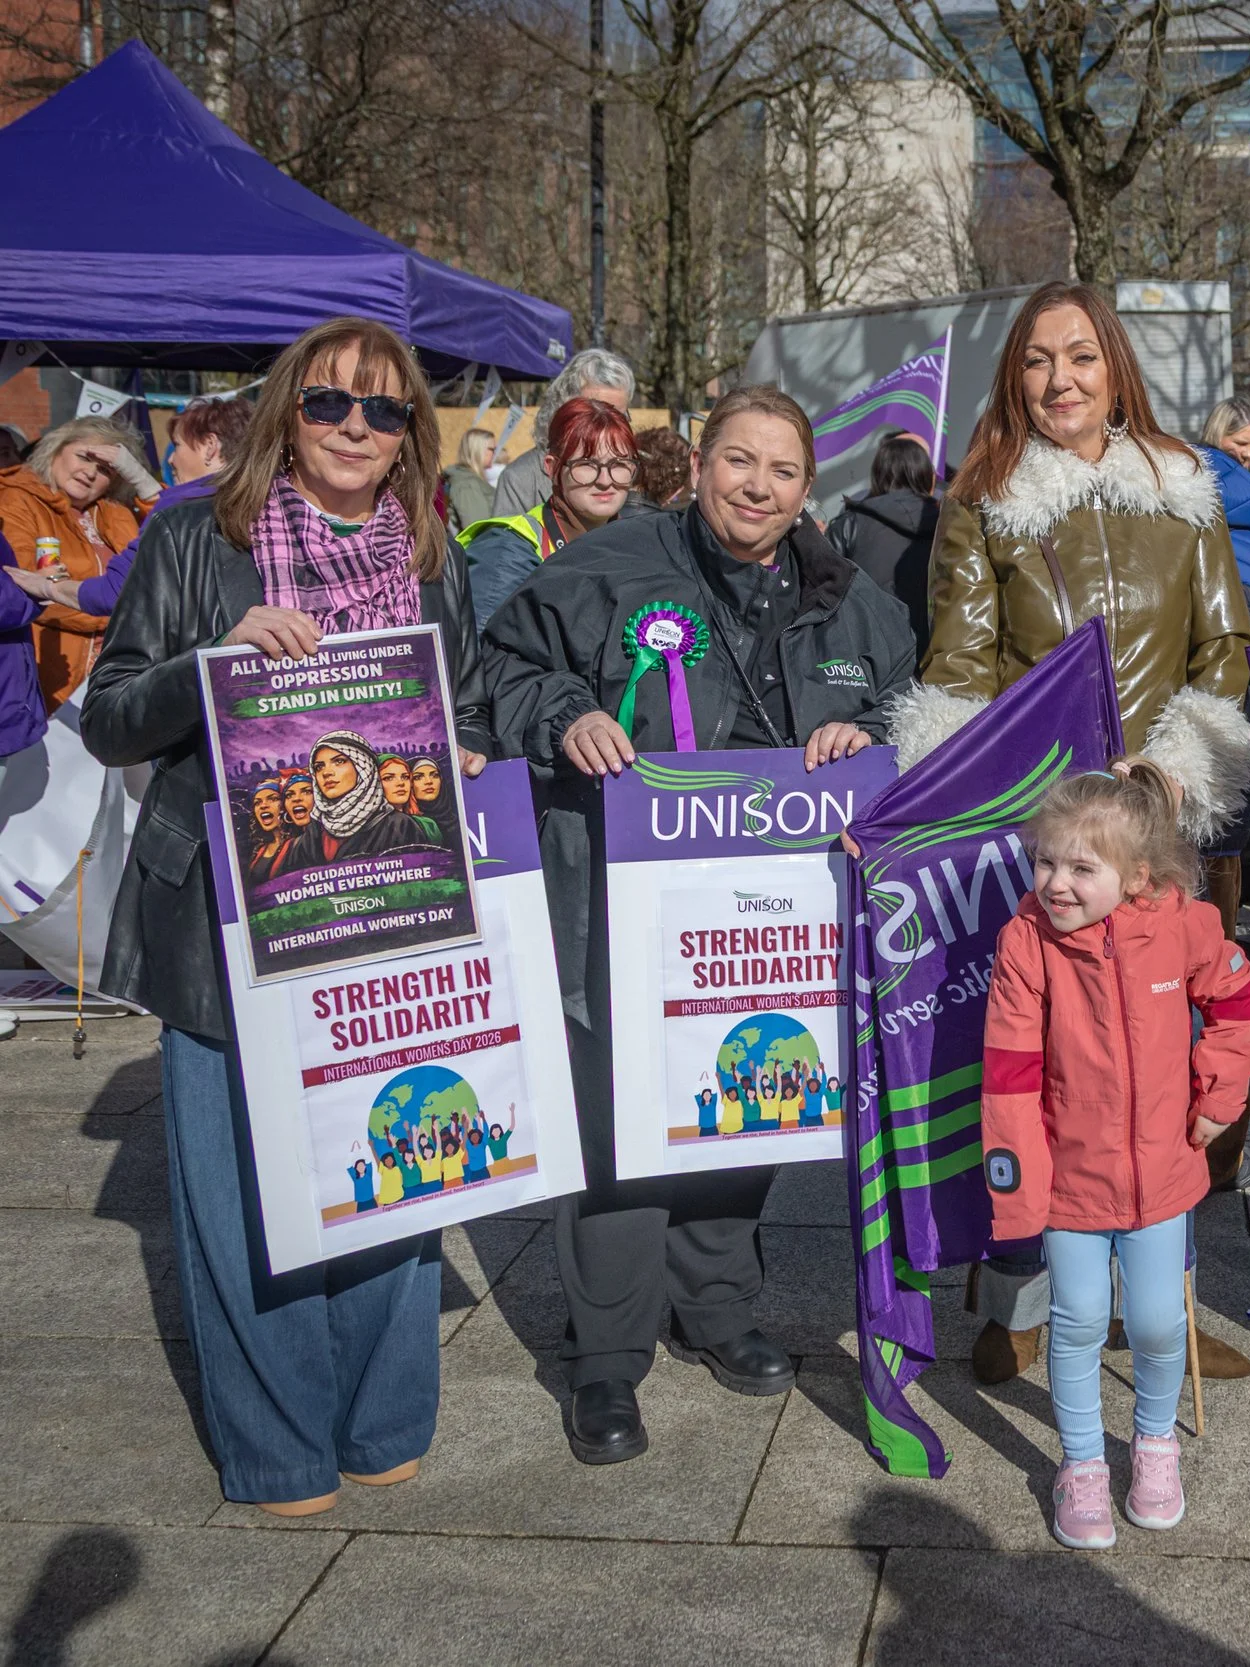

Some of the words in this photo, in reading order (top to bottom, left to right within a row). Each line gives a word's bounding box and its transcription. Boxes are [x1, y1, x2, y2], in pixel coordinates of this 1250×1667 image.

[230, 660, 261, 677] ALL
[262, 651, 330, 672] WOMEN
[332, 649, 367, 663] LIVING
[368, 643, 413, 659] UNDER
[271, 663, 383, 690] OPPRESSION
[258, 692, 317, 713] STAND
[320, 689, 340, 704] IN
[342, 682, 403, 701] UNITY!
[651, 790, 854, 841] UNISON
[274, 882, 335, 905] WOMEN
[338, 867, 432, 892] EVERYWHERE
[302, 862, 372, 885] SOLIDARITY
[374, 859, 403, 871] WITH
[334, 896, 386, 915] UNISON
[737, 898, 793, 913] UNISON
[268, 922, 367, 953] INTERNATIONAL
[367, 911, 427, 931] WOMEN'S
[428, 907, 454, 922] DAY
[679, 924, 810, 958] STRENGTH
[820, 922, 844, 949] IN
[312, 963, 456, 1019] STRENGTH
[463, 957, 492, 989] IN
[692, 953, 841, 989] SOLIDARITY
[330, 991, 491, 1051] SOLIDARITY
[681, 999, 754, 1015] INTERNATIONAL
[756, 994, 801, 1010] WOMEN'S
[803, 993, 822, 1006] DAY
[824, 992, 848, 1004] 2026
[323, 1055, 404, 1082] INTERNATIONAL
[405, 1043, 451, 1064] WOMENS
[452, 1037, 473, 1054] DAY
[475, 1031, 502, 1049] 2026
